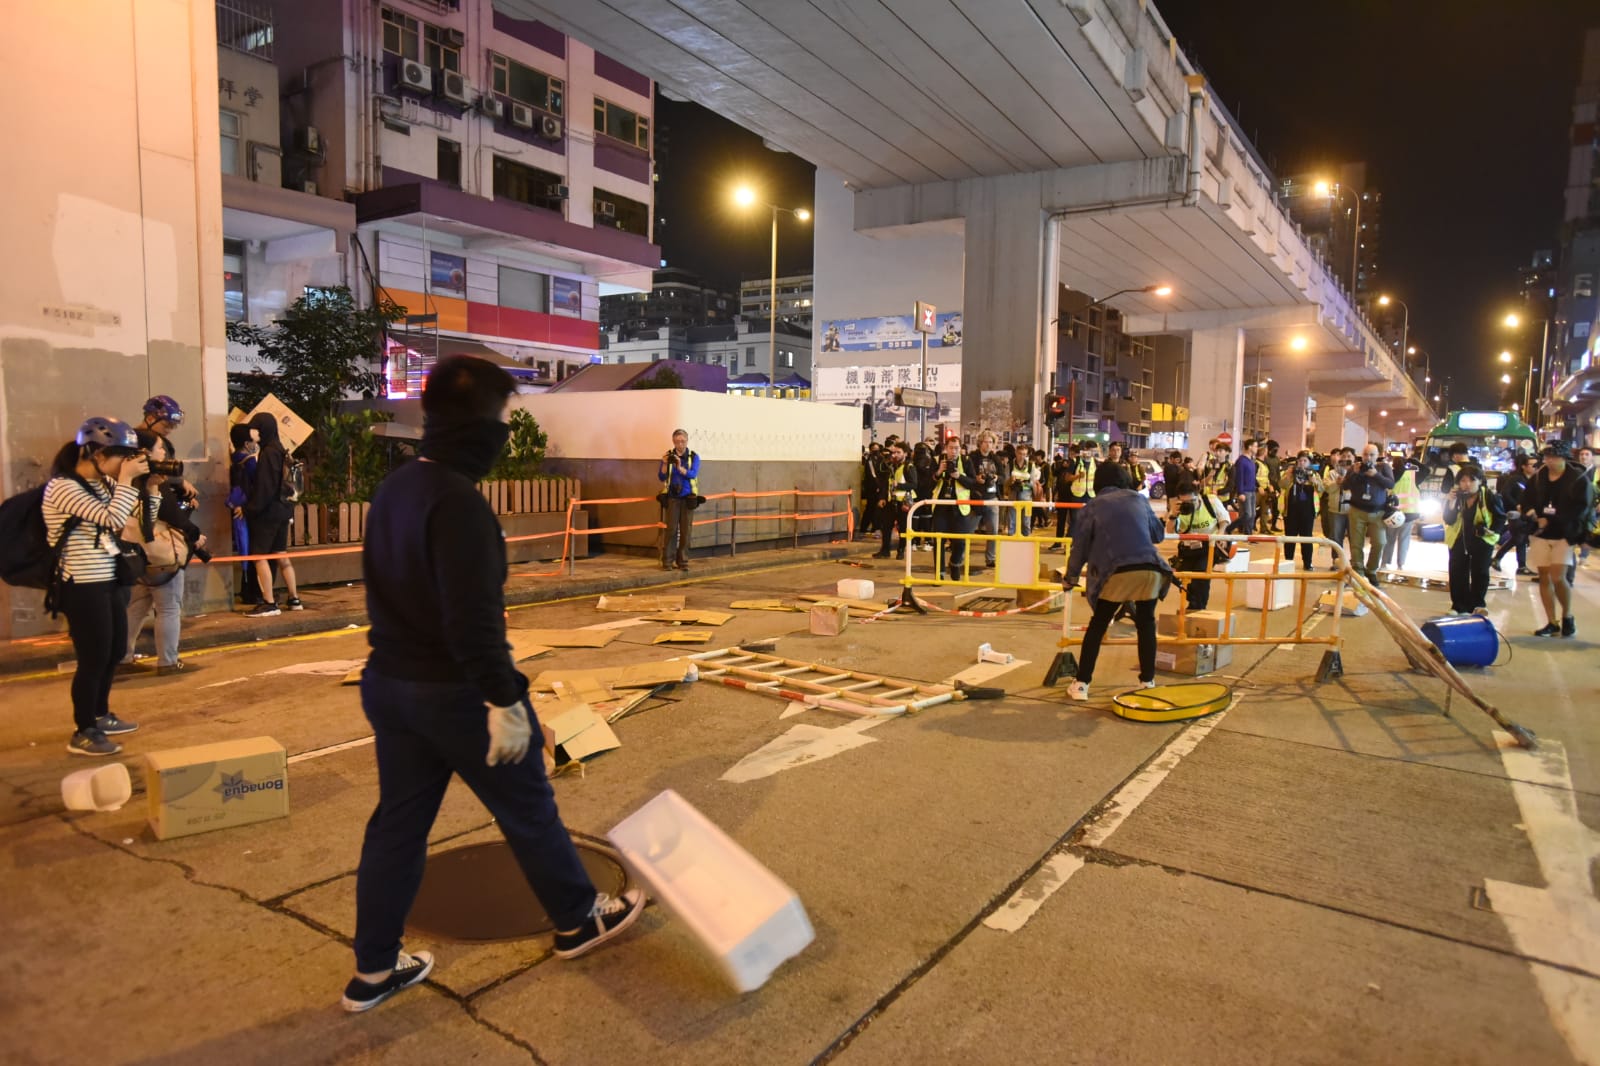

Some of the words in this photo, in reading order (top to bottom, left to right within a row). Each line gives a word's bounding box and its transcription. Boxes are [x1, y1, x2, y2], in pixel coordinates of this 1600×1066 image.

[846, 368, 911, 385] 機動部隊
[224, 779, 283, 797] Bonaqua
